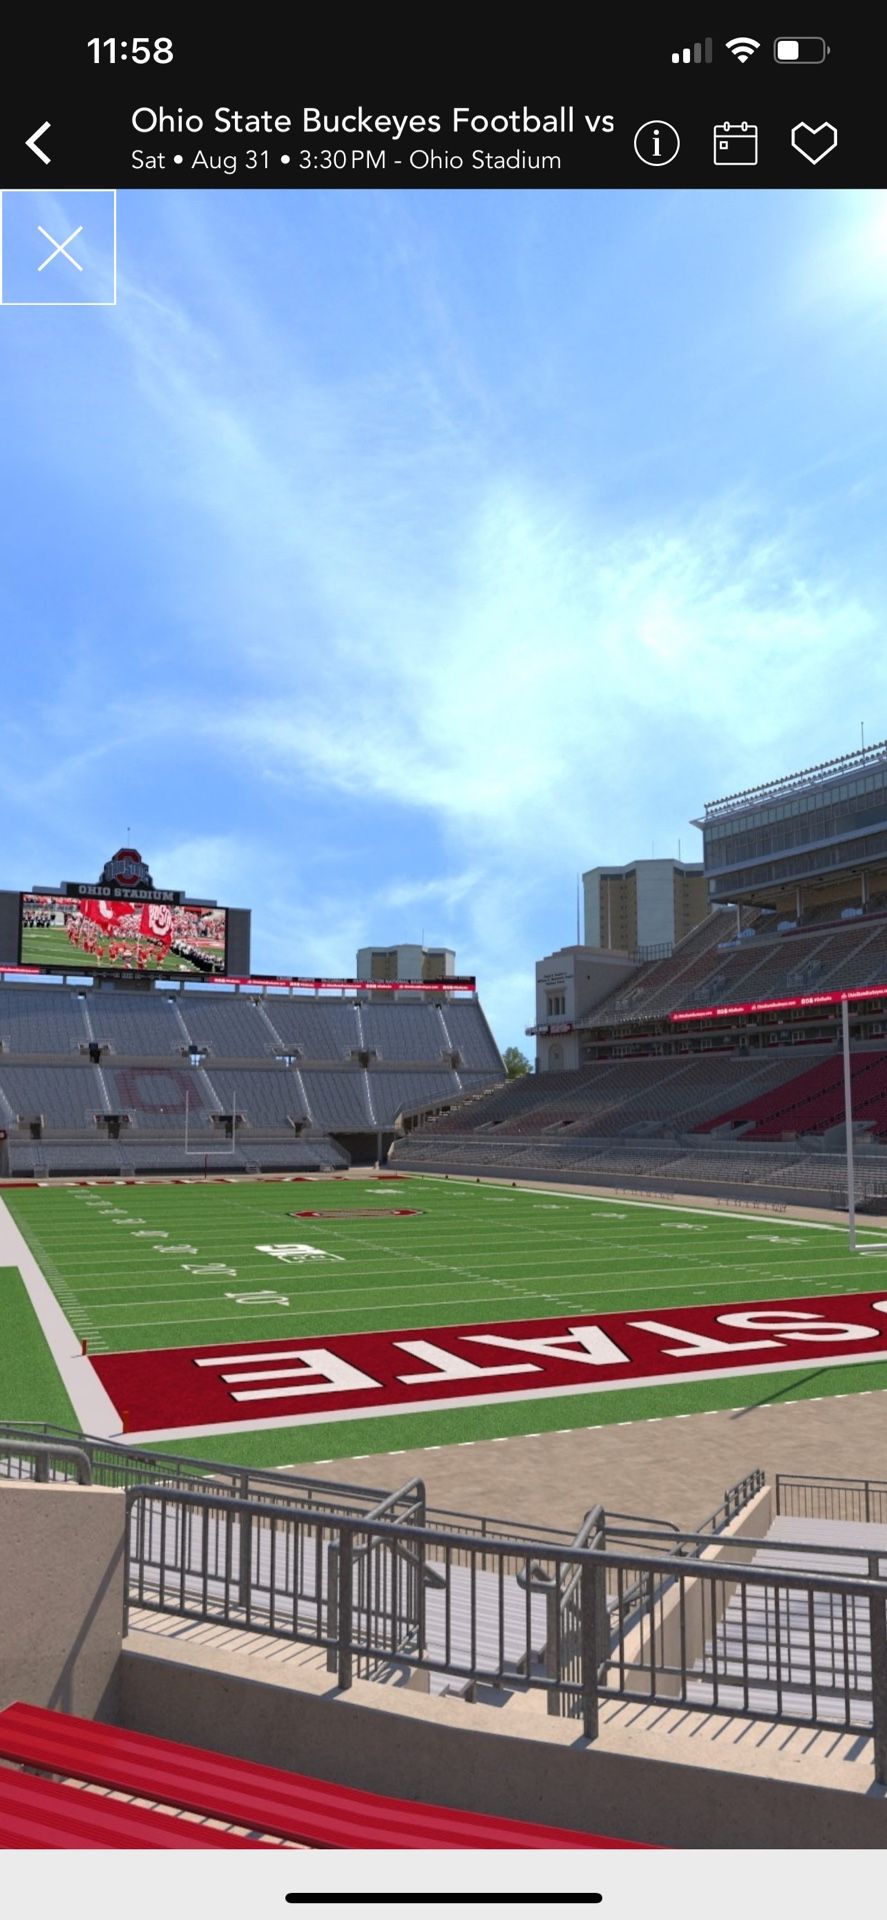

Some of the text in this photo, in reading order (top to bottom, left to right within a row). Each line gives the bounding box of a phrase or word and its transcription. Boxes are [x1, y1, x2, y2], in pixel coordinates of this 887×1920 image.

[87, 37, 174, 64] 11:58
[131, 106, 615, 140] Ohio State Buckeyes Football vs
[131, 149, 561, 175] Sat Aug 31 3:30 PM Ohio Stadium
[78, 885, 174, 901] OHIO STADIUM
[224, 1290, 289, 1306] 10
[194, 1311, 880, 1402] STATE
